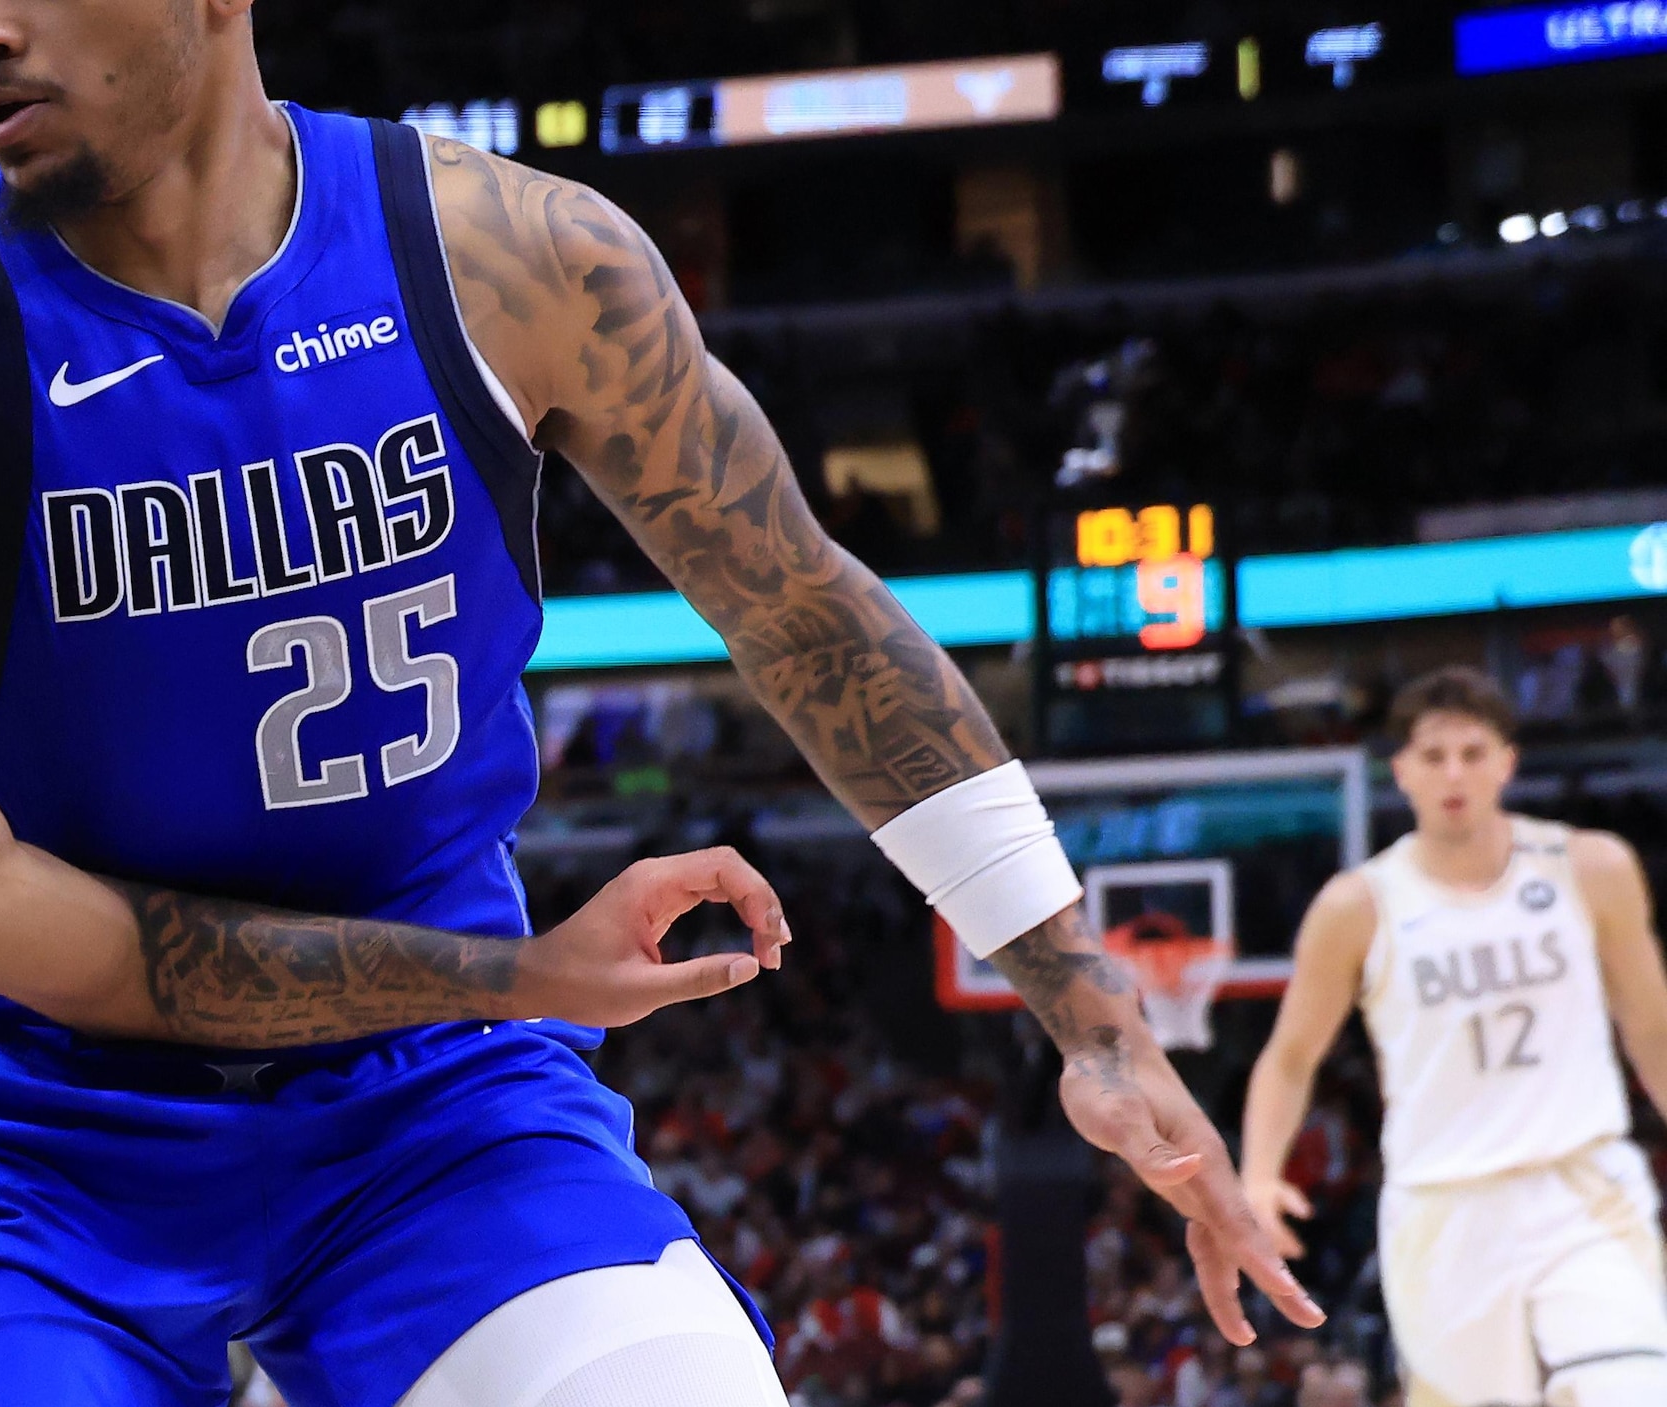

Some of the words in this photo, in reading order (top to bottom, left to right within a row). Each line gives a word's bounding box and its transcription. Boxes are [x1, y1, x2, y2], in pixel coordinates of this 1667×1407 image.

[273, 312, 399, 374] chime
[42, 412, 455, 623] DALLAS
[1137, 552, 1207, 650] 9
[247, 573, 460, 811] 25
[1413, 929, 1568, 1007] BULLS
[1470, 1001, 1542, 1074] 12
